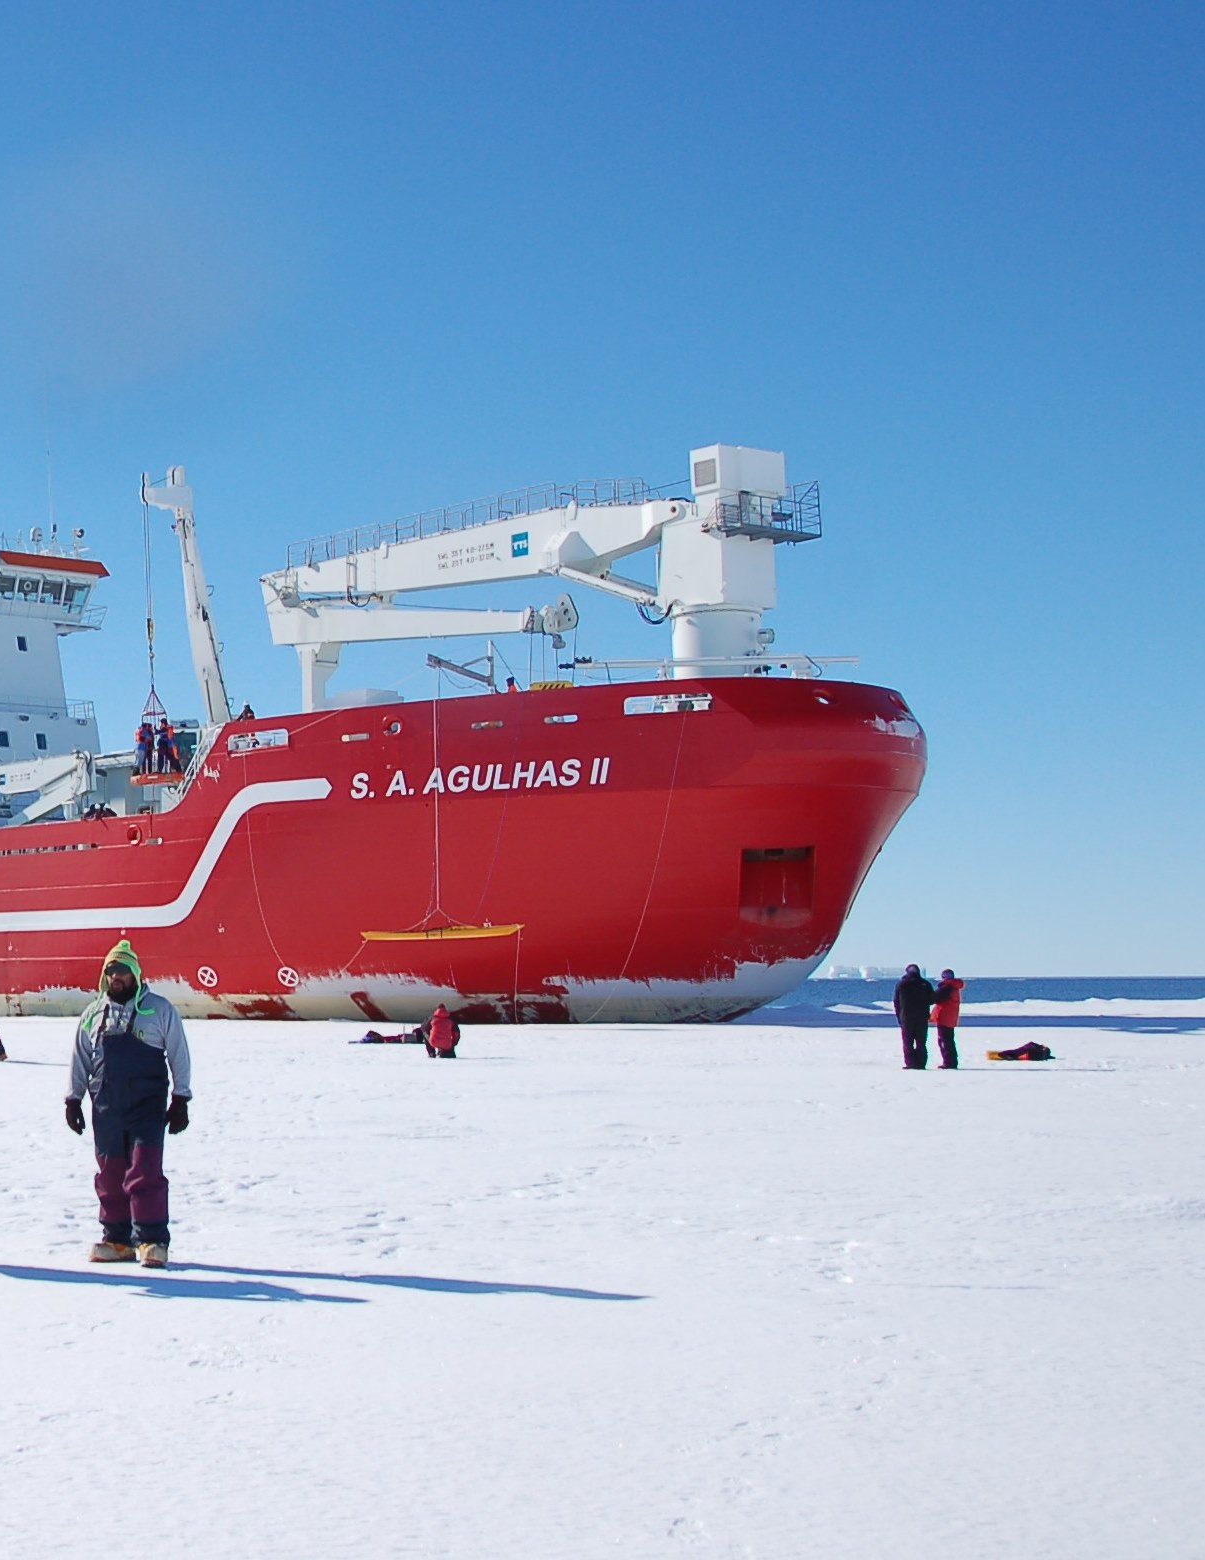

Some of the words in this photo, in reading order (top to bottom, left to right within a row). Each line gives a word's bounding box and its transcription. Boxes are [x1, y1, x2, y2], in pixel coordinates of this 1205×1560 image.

[350, 772, 375, 799] S.
[385, 769, 415, 797] A.
[422, 758, 582, 795] AGULHAS
[589, 757, 610, 785] II
